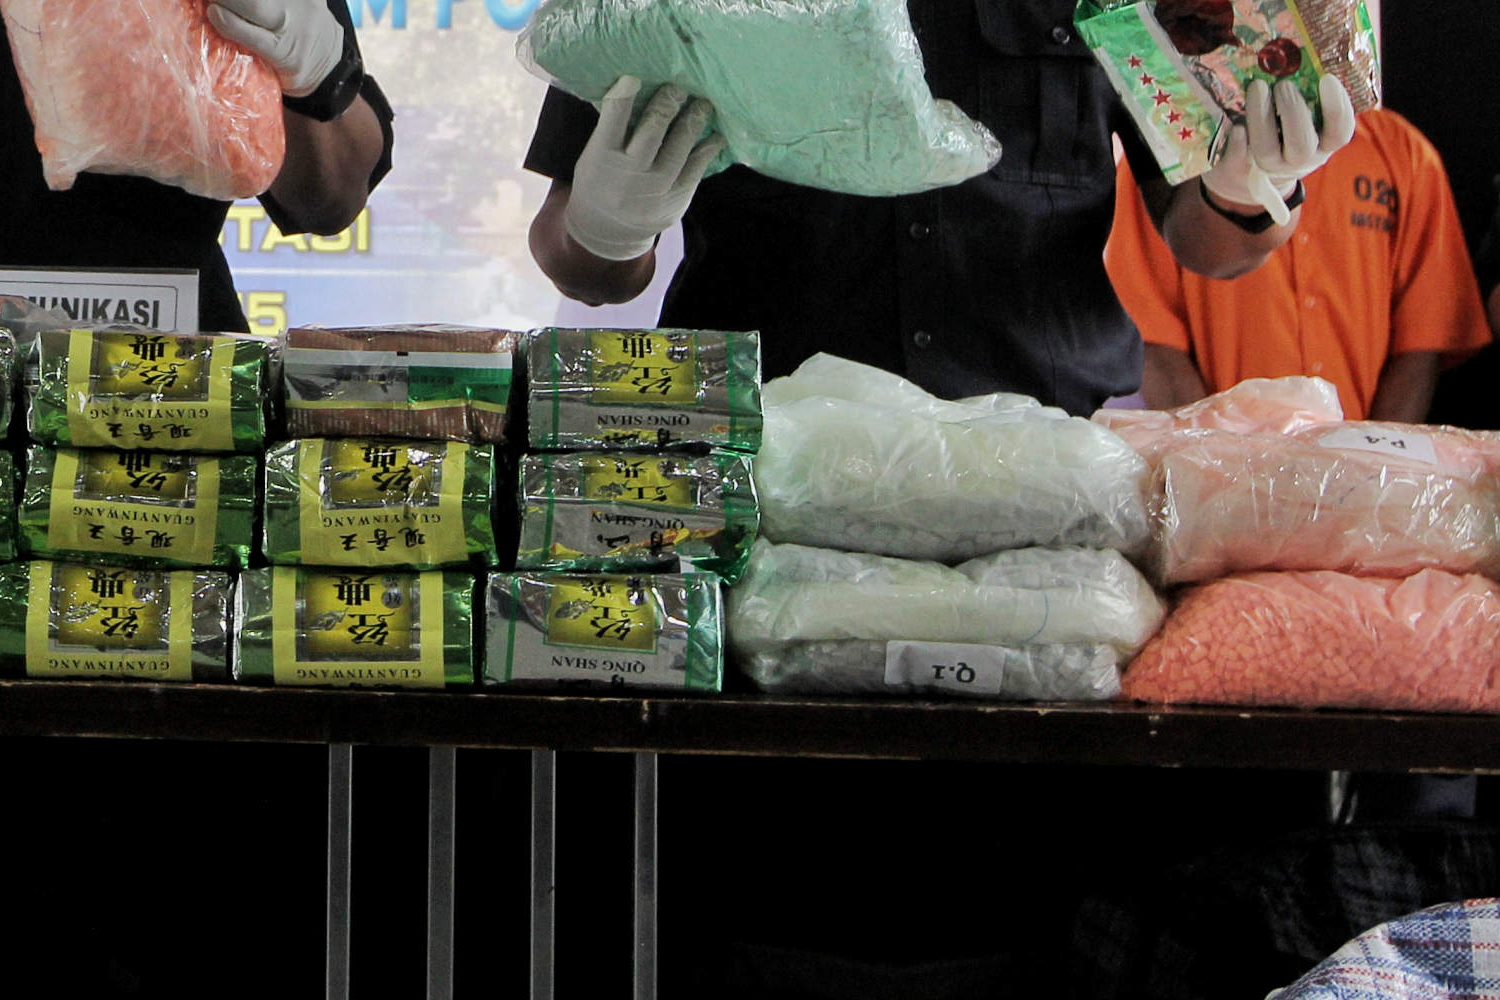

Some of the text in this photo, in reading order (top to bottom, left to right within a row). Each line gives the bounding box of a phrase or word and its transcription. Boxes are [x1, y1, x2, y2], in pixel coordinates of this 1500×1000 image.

[597, 414, 690, 427] QING SHAN
[73, 505, 196, 525] GUANYINWANG
[550, 655, 646, 673] QING SHAN
[931, 662, 976, 683] Q.1
[296, 668, 422, 680] GUANYINWANG
